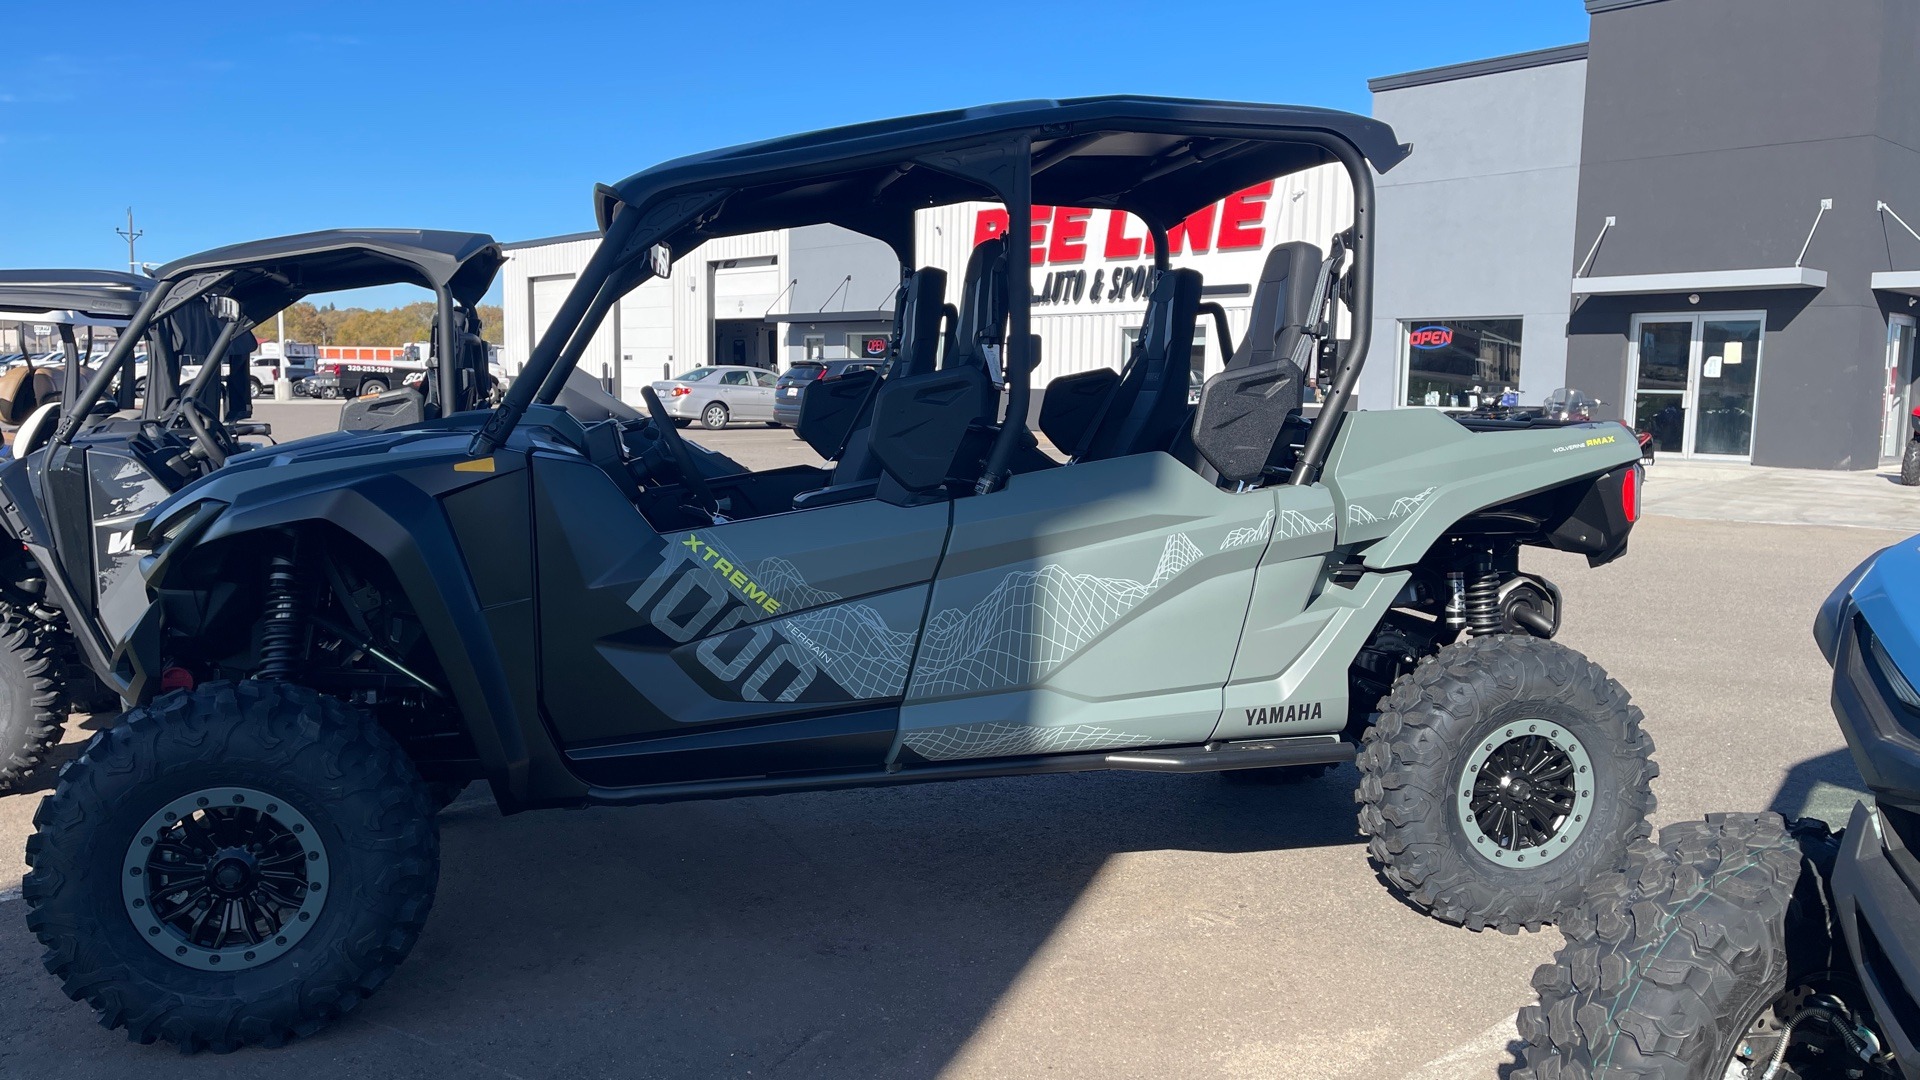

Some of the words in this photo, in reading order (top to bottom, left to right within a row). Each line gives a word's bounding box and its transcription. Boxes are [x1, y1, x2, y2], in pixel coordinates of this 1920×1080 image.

[1104, 179, 1274, 258] LNE
[1041, 268, 1087, 306] AUTO
[1089, 268, 1105, 304] &
[1107, 265, 1160, 304] SPOR
[1409, 330, 1453, 345] OPEN
[1552, 442, 1586, 453] WOLVERINE
[625, 536, 818, 702] 1000
[682, 534, 781, 614] XTREME
[785, 621, 833, 664] TERRAIN
[1245, 702, 1322, 726] YAMAHA
